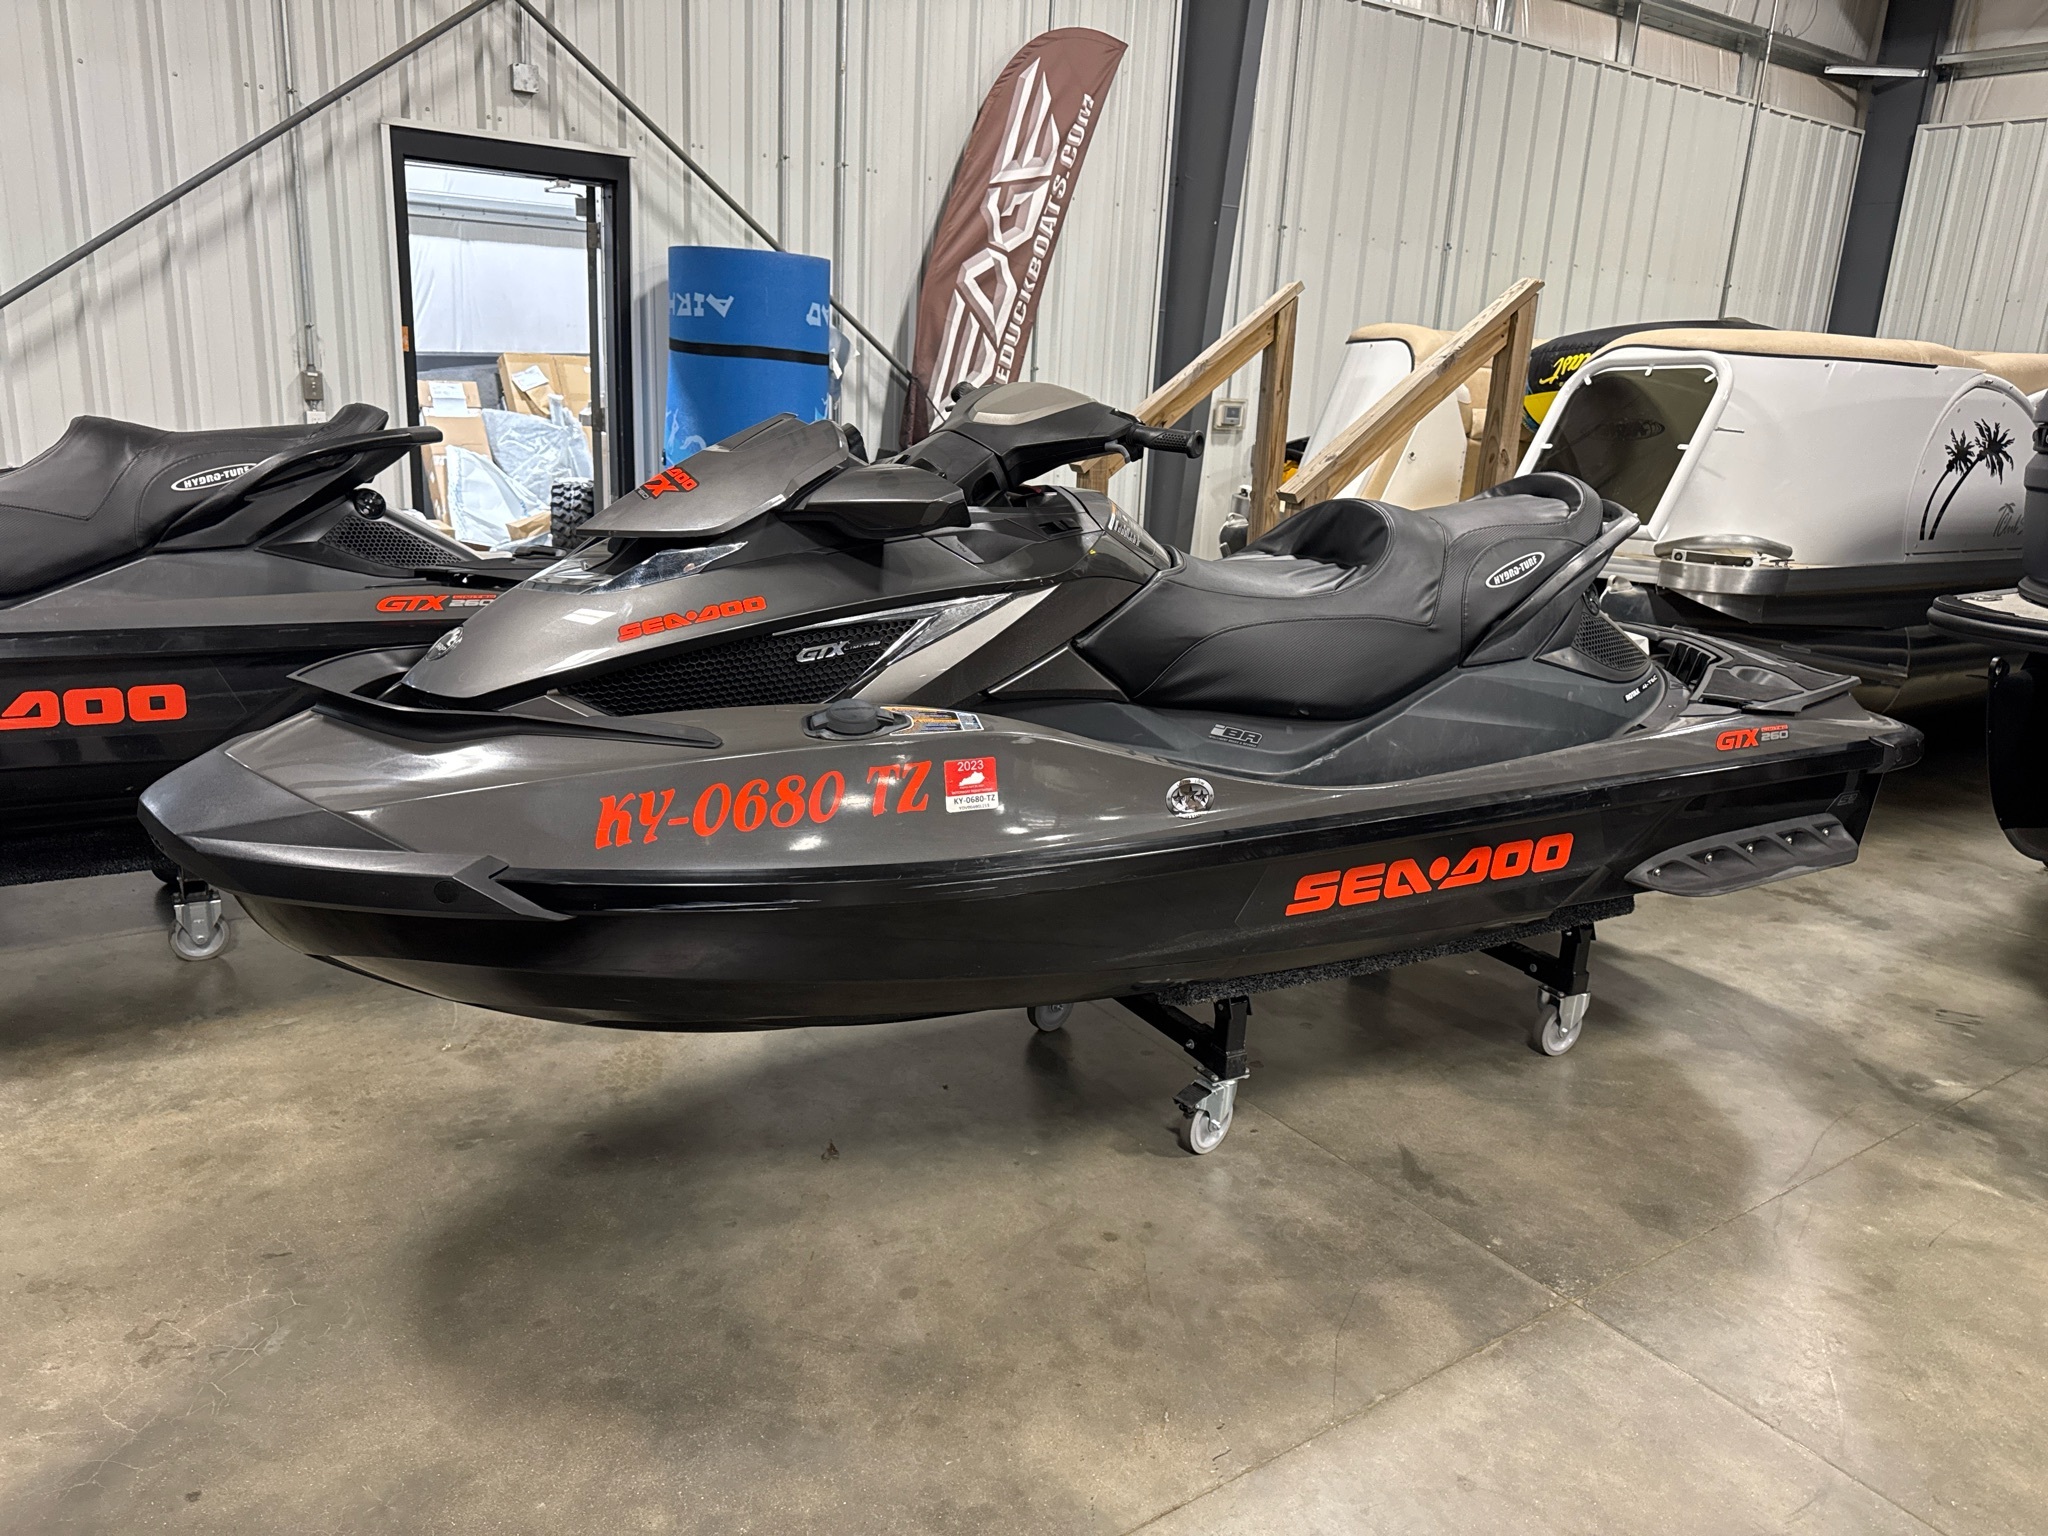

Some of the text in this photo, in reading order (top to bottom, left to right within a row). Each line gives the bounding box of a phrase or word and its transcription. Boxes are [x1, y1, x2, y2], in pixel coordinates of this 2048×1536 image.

[927, 57, 1060, 432] EDGE
[1493, 555, 1538, 585] HYDRO-TURF
[376, 595, 449, 611] GTX
[796, 640, 850, 663] GTX
[1716, 728, 1789, 750] GTX 260
[957, 760, 984, 771] 2023
[595, 760, 932, 849] KY-0680 TZ
[953, 794, 996, 805] KY-0680-TZ
